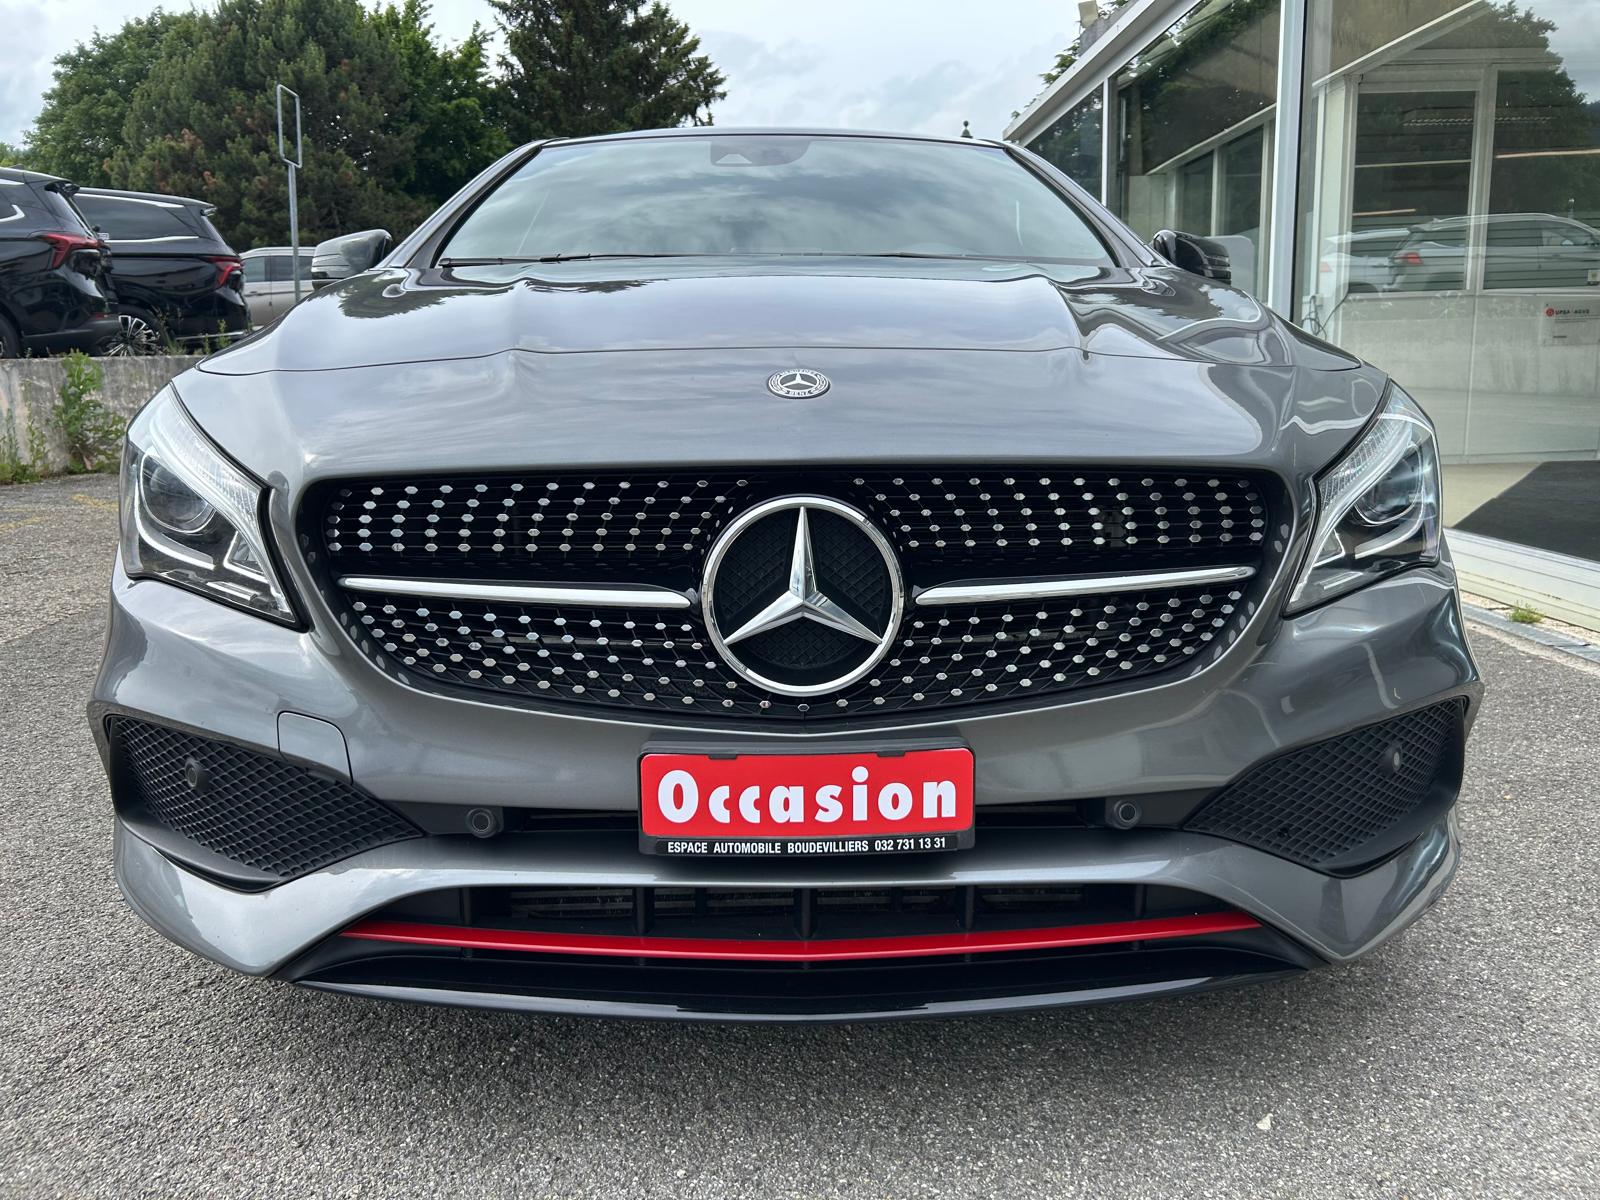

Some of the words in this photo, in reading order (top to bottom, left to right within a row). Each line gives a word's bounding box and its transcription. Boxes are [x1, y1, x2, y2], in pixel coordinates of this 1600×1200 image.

[657, 766, 957, 824] Occasion
[667, 841, 708, 853] ESPACE
[713, 842, 782, 854] AUTOMOBILE
[787, 840, 869, 854] BOUDEVILLIERS
[874, 839, 894, 851] 032
[896, 838, 915, 850] 731
[918, 837, 931, 849] 13
[933, 837, 946, 848] 31
